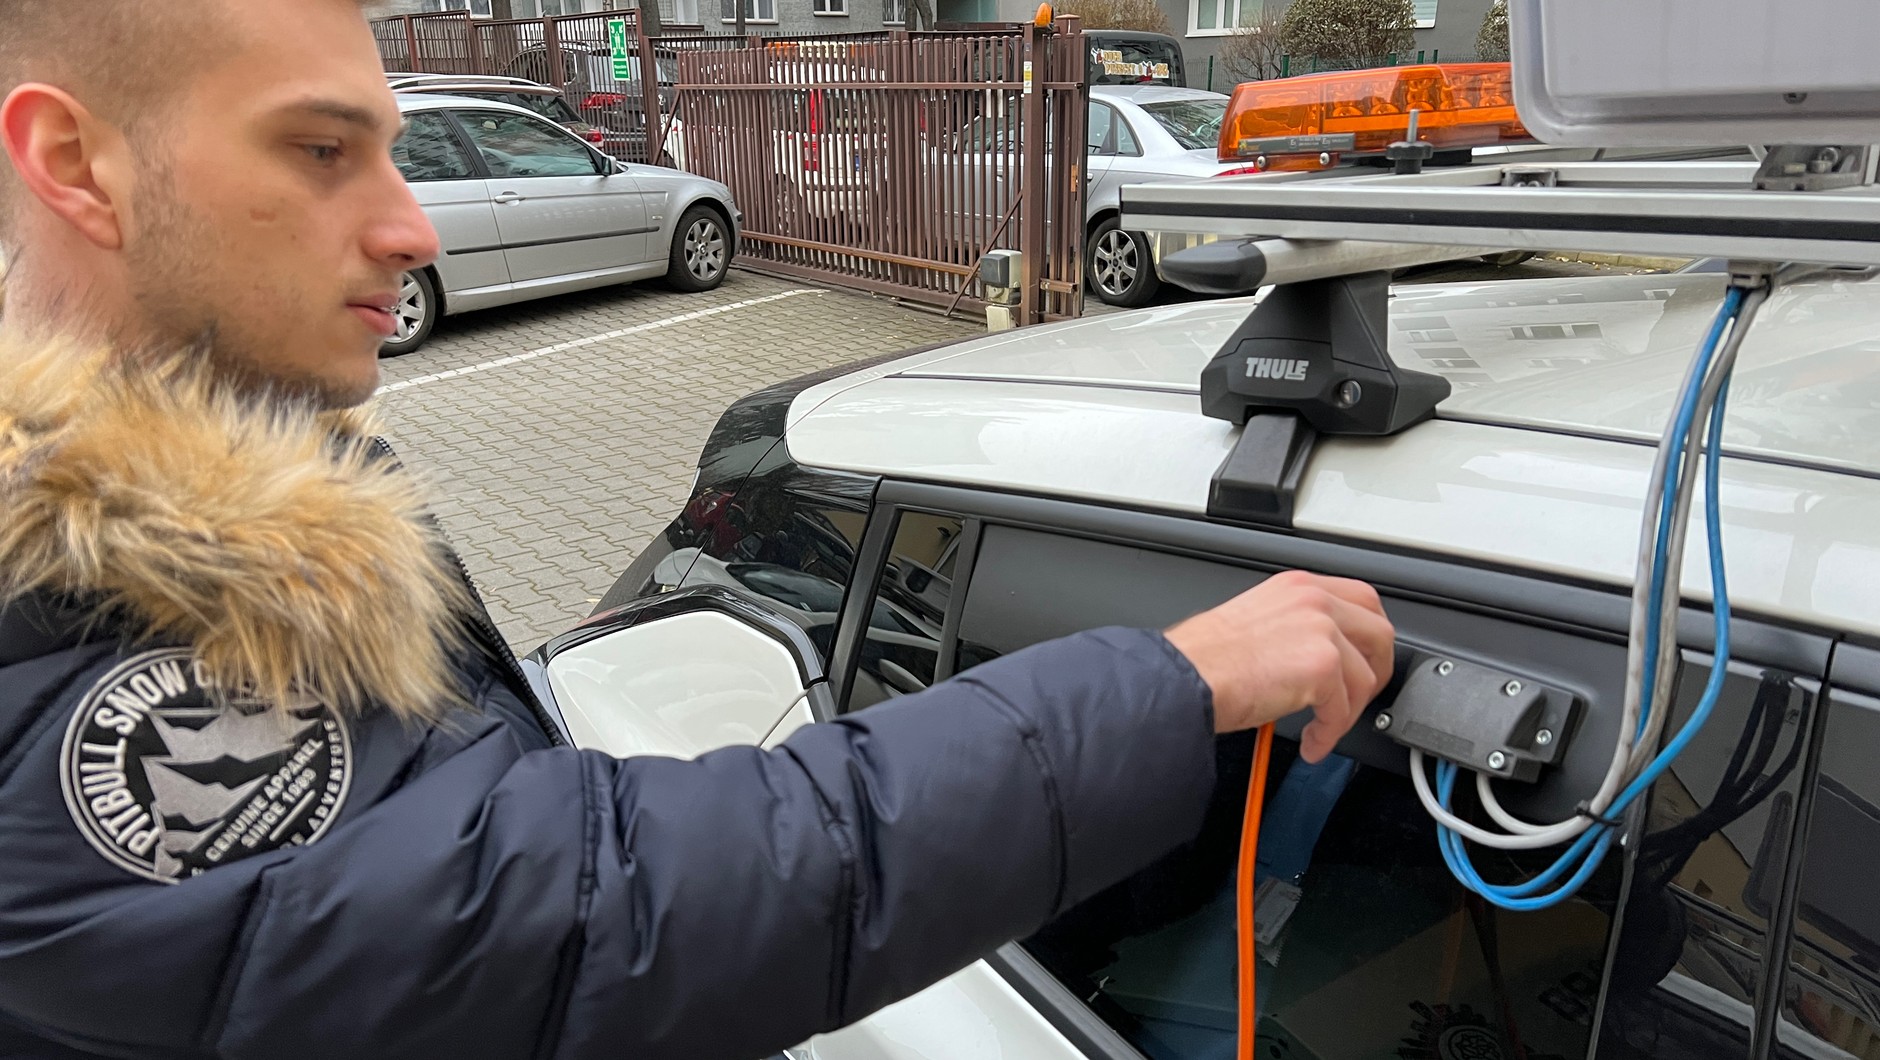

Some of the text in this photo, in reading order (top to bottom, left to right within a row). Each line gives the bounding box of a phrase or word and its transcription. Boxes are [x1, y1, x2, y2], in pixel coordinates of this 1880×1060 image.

[1245, 357, 1309, 380] THULE
[80, 660, 188, 856] PITBULL SNOW
[205, 795, 269, 862] GENUINE
[264, 739, 324, 800] APPAREL
[241, 801, 286, 849] SINCE
